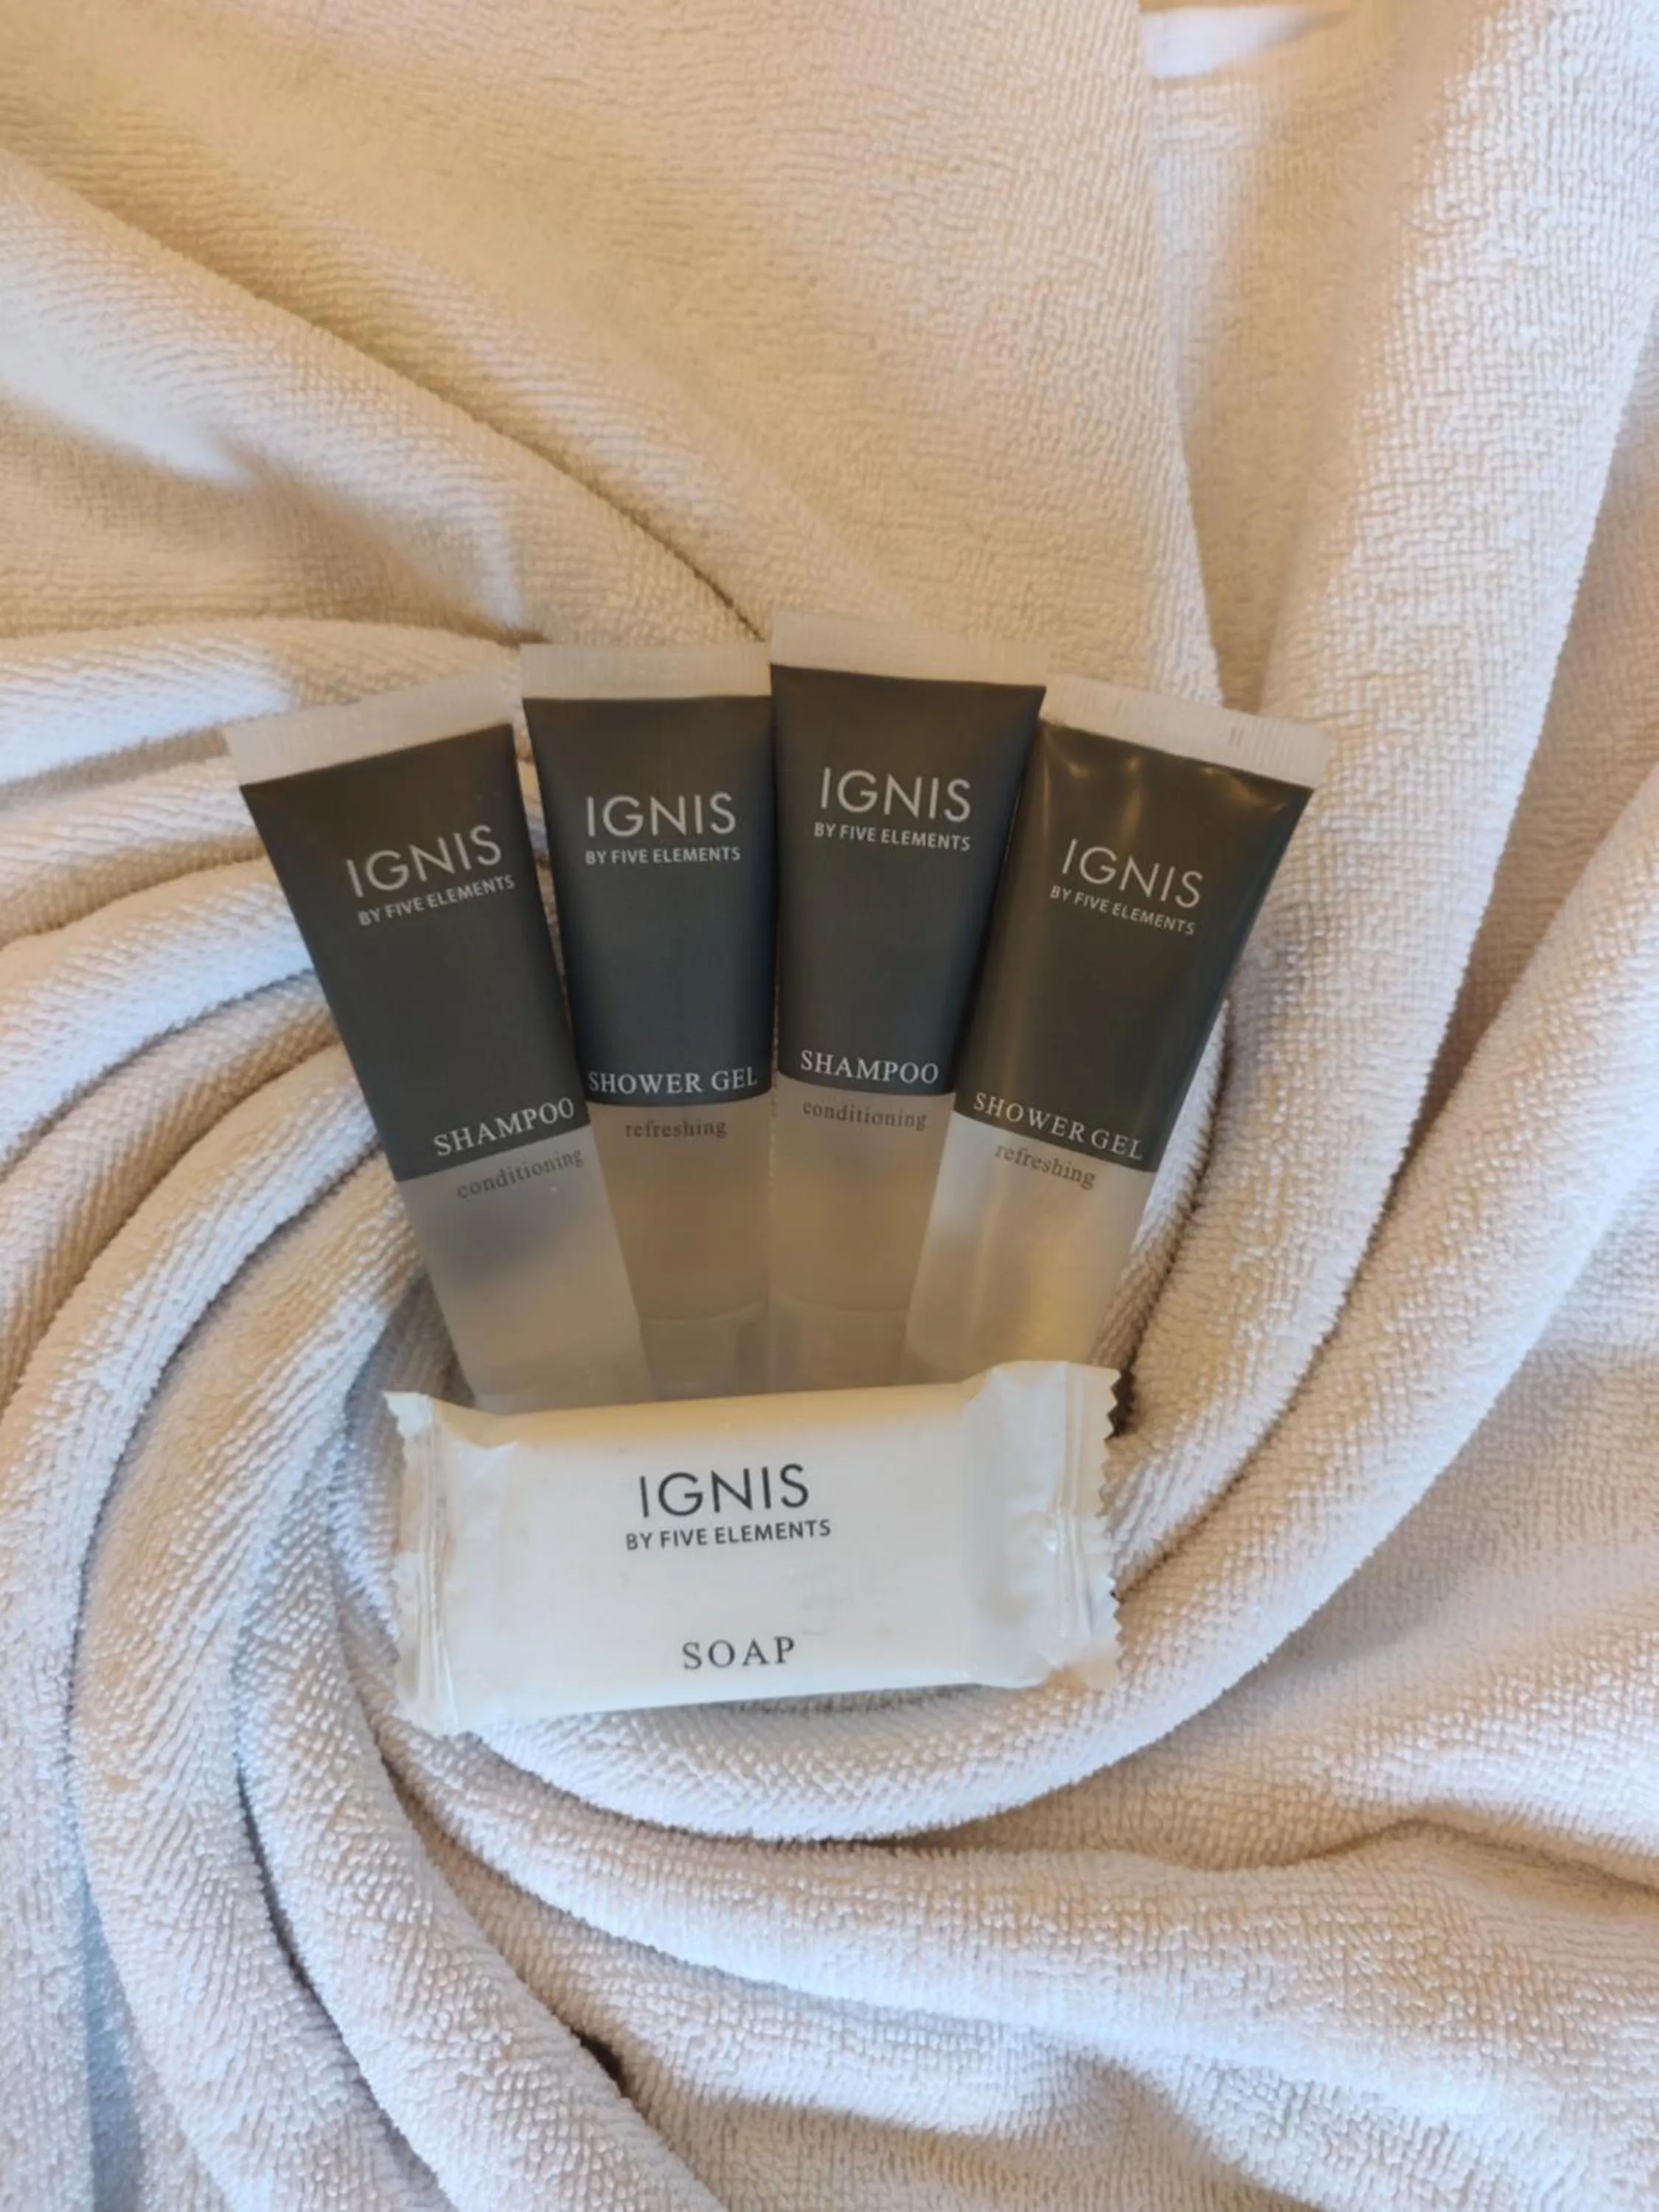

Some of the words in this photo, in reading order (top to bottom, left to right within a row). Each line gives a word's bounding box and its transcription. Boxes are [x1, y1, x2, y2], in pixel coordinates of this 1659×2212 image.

[586, 792, 737, 837] IGNIS
[820, 768, 971, 822] IGNIS
[346, 824, 502, 897] IGNIS
[585, 850, 607, 865] BY
[611, 849, 649, 863] FIVE
[653, 846, 741, 863] ELEMENTS
[814, 822, 836, 838] BY
[840, 825, 876, 843] FIVE
[881, 828, 970, 851] ELEMENTS
[1061, 838, 1203, 908] IGNIS
[358, 908, 383, 926] BY
[386, 896, 425, 918] FIVE
[428, 874, 515, 908] ELEMENTS
[1050, 886, 1071, 903] BY
[1074, 891, 1108, 913] FIVE
[1112, 902, 1196, 935] ELEMENTS
[588, 1071, 700, 1095] SHOWER
[712, 1066, 757, 1090] GEL
[801, 1049, 939, 1085] SHAMPOO
[434, 1097, 575, 1157] SHAMPOO
[625, 1119, 727, 1139] refreshing
[803, 1101, 928, 1131] conditioning
[973, 1091, 1086, 1143] SHOWER
[1091, 1130, 1144, 1160] GEL
[456, 1148, 583, 1199] conditioning
[995, 1142, 1096, 1191] refreshing
[639, 1463, 810, 1519] IGNIS
[626, 1531, 653, 1551] BY
[660, 1526, 709, 1548] FIVE
[714, 1518, 832, 1545] ELEMENTS
[681, 1635, 796, 1670] SOAP
